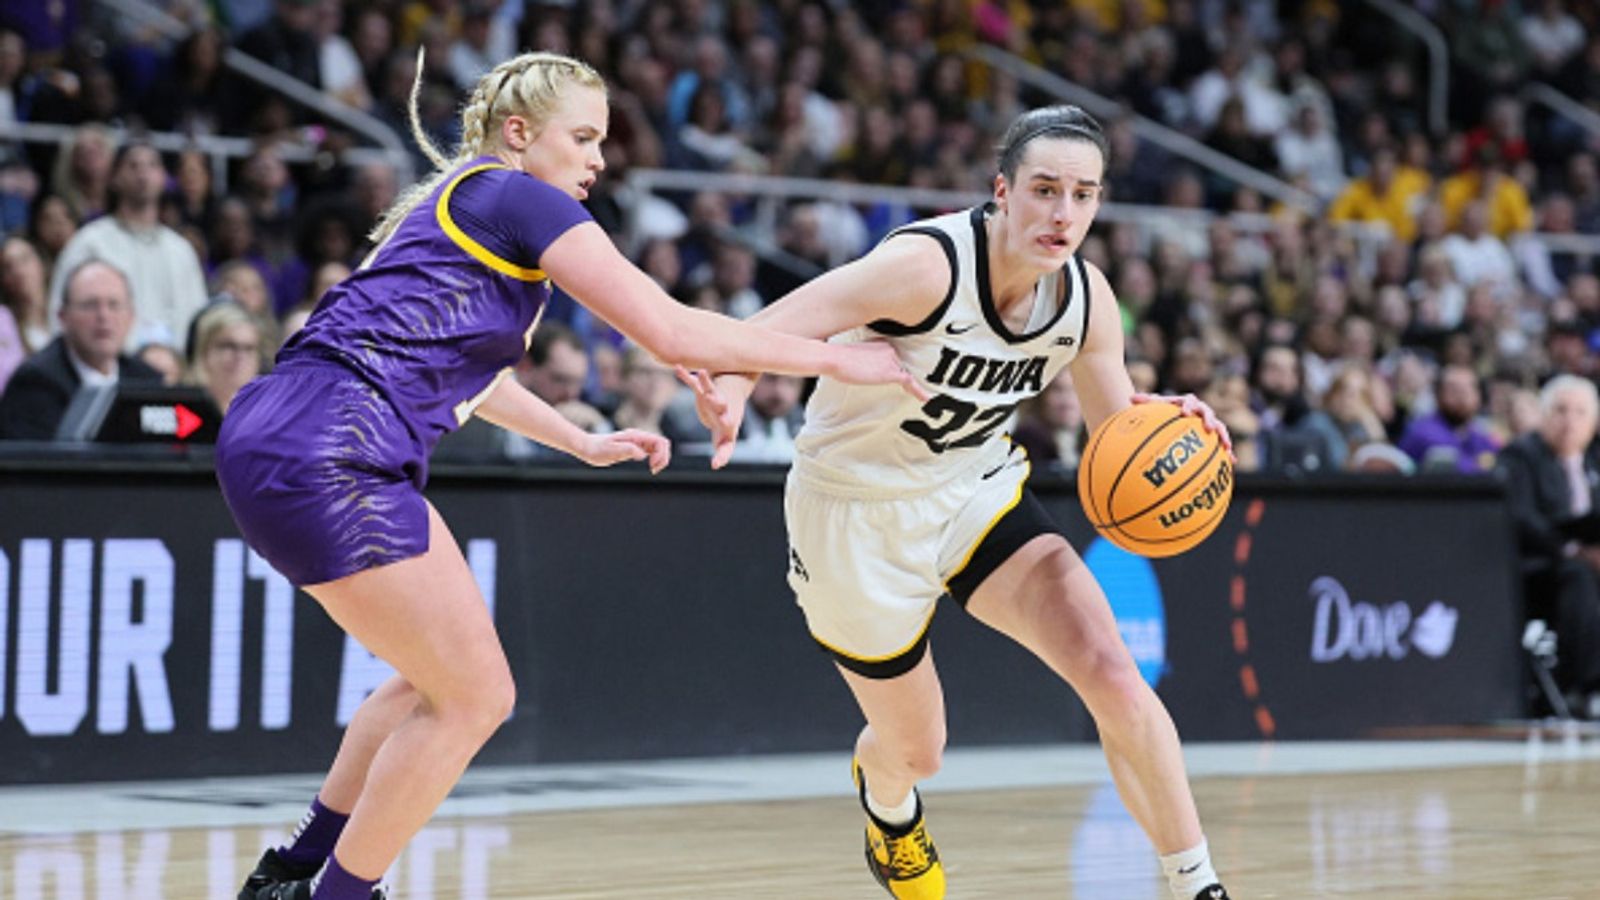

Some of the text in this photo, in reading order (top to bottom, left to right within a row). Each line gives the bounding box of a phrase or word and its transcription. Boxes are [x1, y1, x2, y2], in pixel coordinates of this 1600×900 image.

[926, 345, 1048, 393] IOWA
[900, 394, 1016, 454] 22
[1142, 429, 1203, 488] NCAA
[1158, 460, 1230, 528] Wilson
[0, 538, 175, 736] UR
[1309, 576, 1412, 663] Dove
